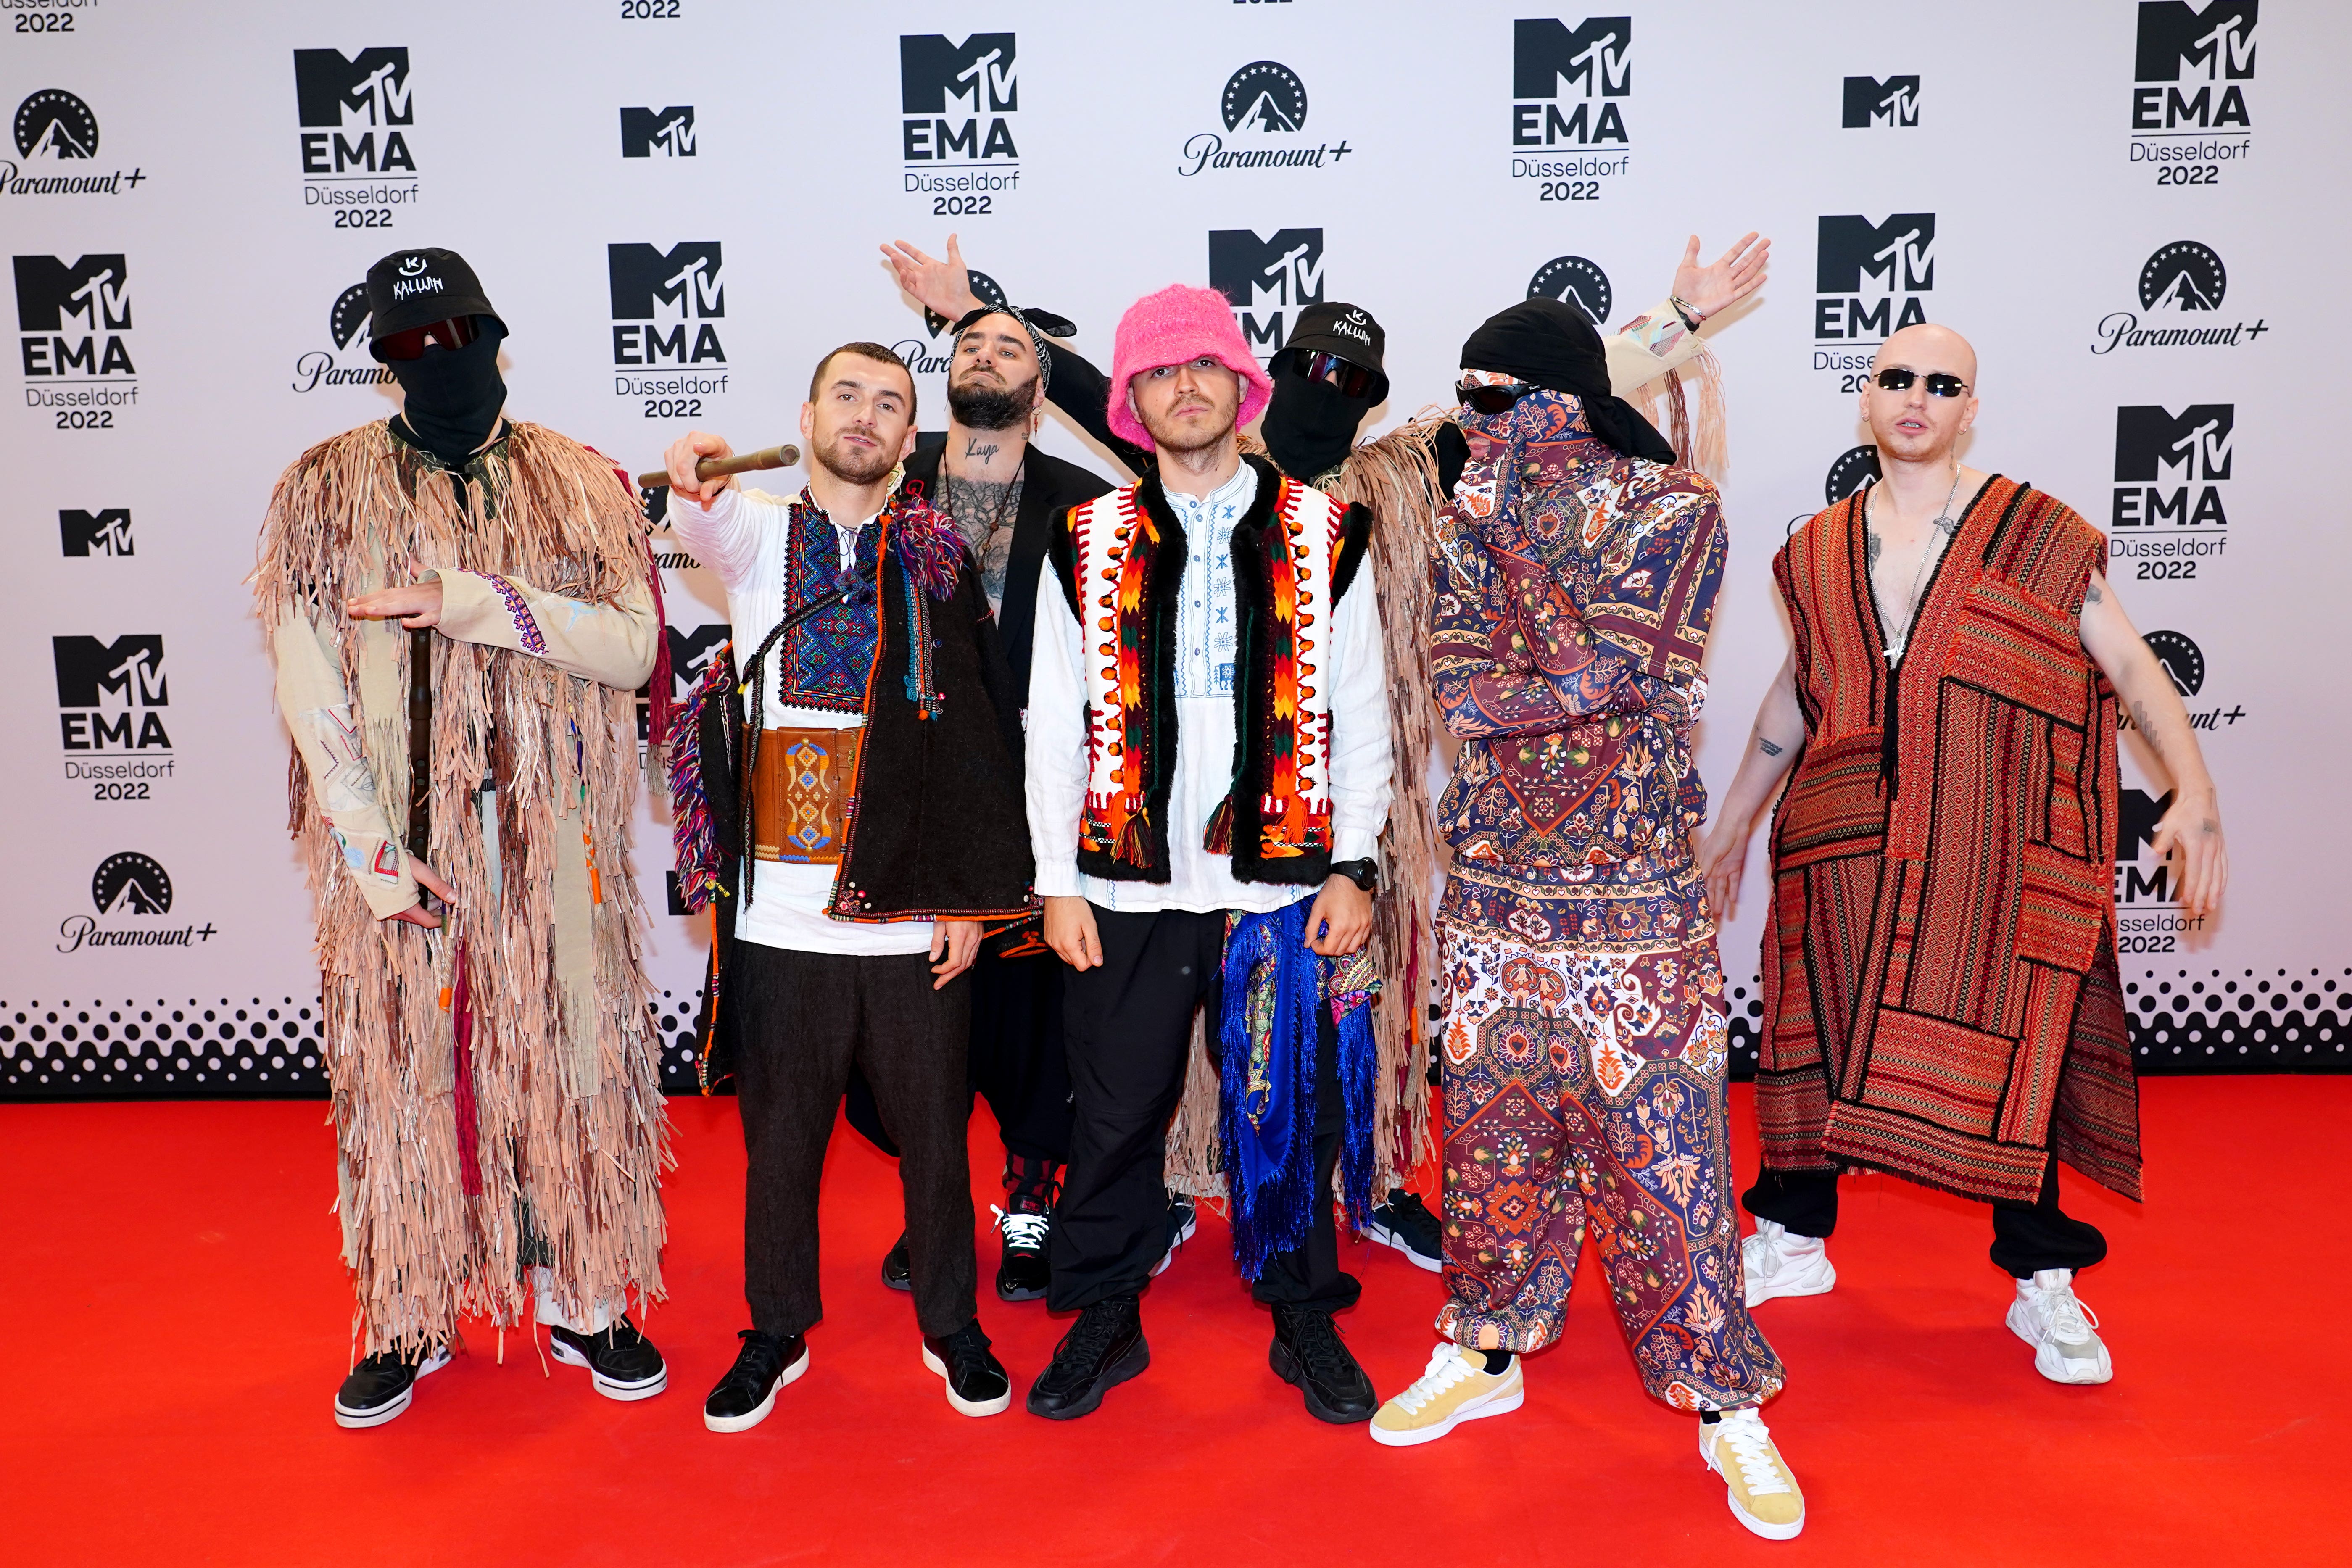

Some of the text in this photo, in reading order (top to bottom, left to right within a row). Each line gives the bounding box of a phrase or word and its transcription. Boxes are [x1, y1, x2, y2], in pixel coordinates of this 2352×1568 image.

[15, 13, 74, 32] 2022
[622, 0, 680, 18] 2022
[1514, 16, 1631, 99] MTV
[2135, 0, 2258, 82] MTV
[293, 47, 413, 127] MTV
[900, 33, 1017, 113] MTV
[1842, 75, 1920, 128] MTV
[2132, 86, 2250, 129] EMA
[620, 106, 696, 158] MTV
[903, 118, 1018, 160] EMA
[1513, 103, 1628, 145] EMA
[301, 132, 416, 173] EMA
[1179, 133, 1352, 176] Paramount+
[1513, 156, 1628, 177] Düsseldorf
[2131, 140, 2249, 161] Düsseldorf
[305, 185, 418, 204] Düsseldorf
[905, 171, 1019, 192] Düsseldorf
[1540, 182, 1599, 201] 2022
[2158, 165, 2218, 185] 2022
[335, 209, 392, 228] 2022
[934, 196, 991, 215] 2022
[1209, 228, 1324, 307] MTV
[1817, 213, 1935, 293] MTV
[13, 254, 132, 331] MTV
[608, 242, 725, 319] MTV
[1815, 297, 1926, 338] EMA
[2091, 312, 2268, 354] Paramount+
[21, 336, 135, 376] EMA
[613, 324, 726, 364] EMA
[292, 352, 398, 393] Paramo
[616, 376, 728, 395] Düsseldorf
[26, 387, 138, 406] Düsseldorf
[645, 399, 701, 417] 2022
[56, 411, 113, 429] 2022
[2115, 404, 2234, 482] MTV
[2112, 486, 2227, 526] EMA
[59, 509, 134, 557] MTV
[2111, 538, 2226, 557] Düsseldorf
[2137, 561, 2196, 580] 2022
[53, 635, 169, 708] MTV
[61, 712, 172, 750] EMA
[66, 761, 174, 778] Düsseldorf
[95, 783, 150, 800] 2022
[57, 915, 217, 953] Paramount+
[2117, 914, 2205, 931] sseldorf
[2118, 936, 2175, 953] 2022
